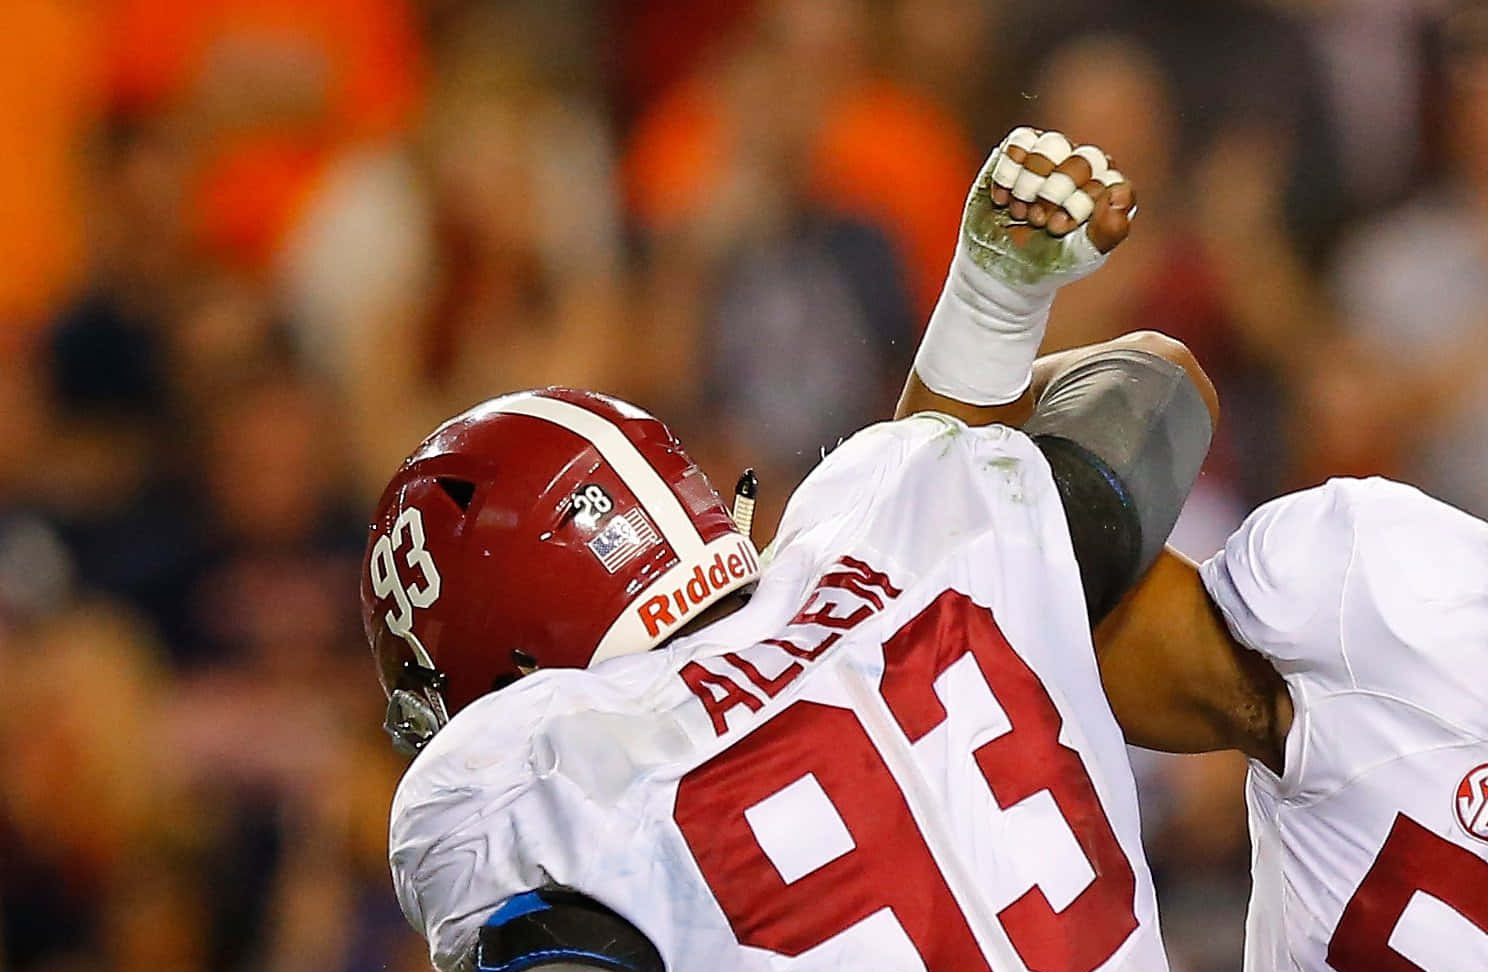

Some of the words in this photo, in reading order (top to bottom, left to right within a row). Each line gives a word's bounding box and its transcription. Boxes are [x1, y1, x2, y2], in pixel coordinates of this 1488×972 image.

[573, 485, 613, 531] 28
[370, 506, 441, 637] 93
[636, 540, 759, 638] Riddell
[678, 555, 904, 737] ALLEN
